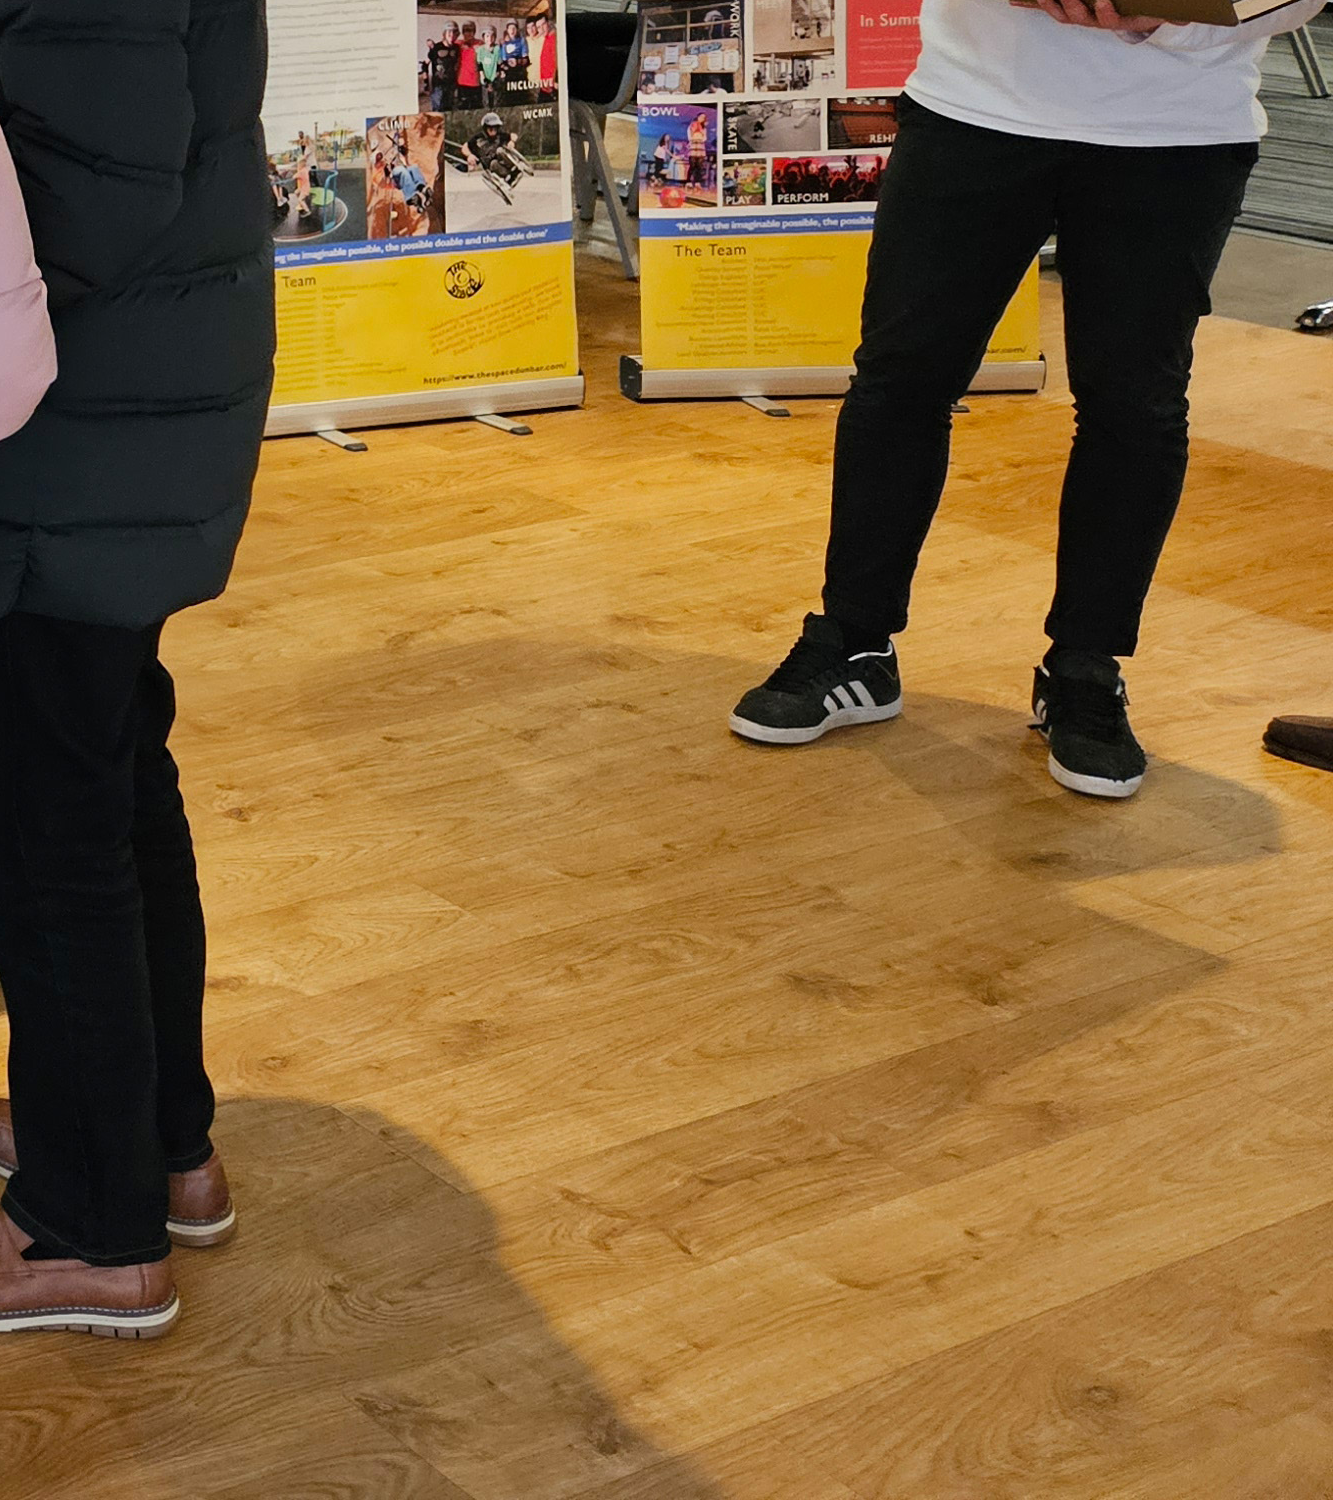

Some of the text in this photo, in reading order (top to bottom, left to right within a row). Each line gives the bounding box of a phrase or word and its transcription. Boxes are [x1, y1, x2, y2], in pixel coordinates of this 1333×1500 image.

[860, 14, 874, 27] In
[507, 79, 554, 91] INCLUSIVE
[523, 107, 553, 119] WCMX
[642, 107, 679, 117] BOWL
[726, 118, 737, 151] SKATE
[725, 195, 752, 204] PLAY
[777, 193, 829, 203] PERFORM
[385, 243, 399, 252] the
[435, 237, 463, 247] doable
[465, 236, 481, 244] and
[482, 234, 497, 243] the
[674, 244, 746, 256] The Team
[281, 276, 316, 288] Team
